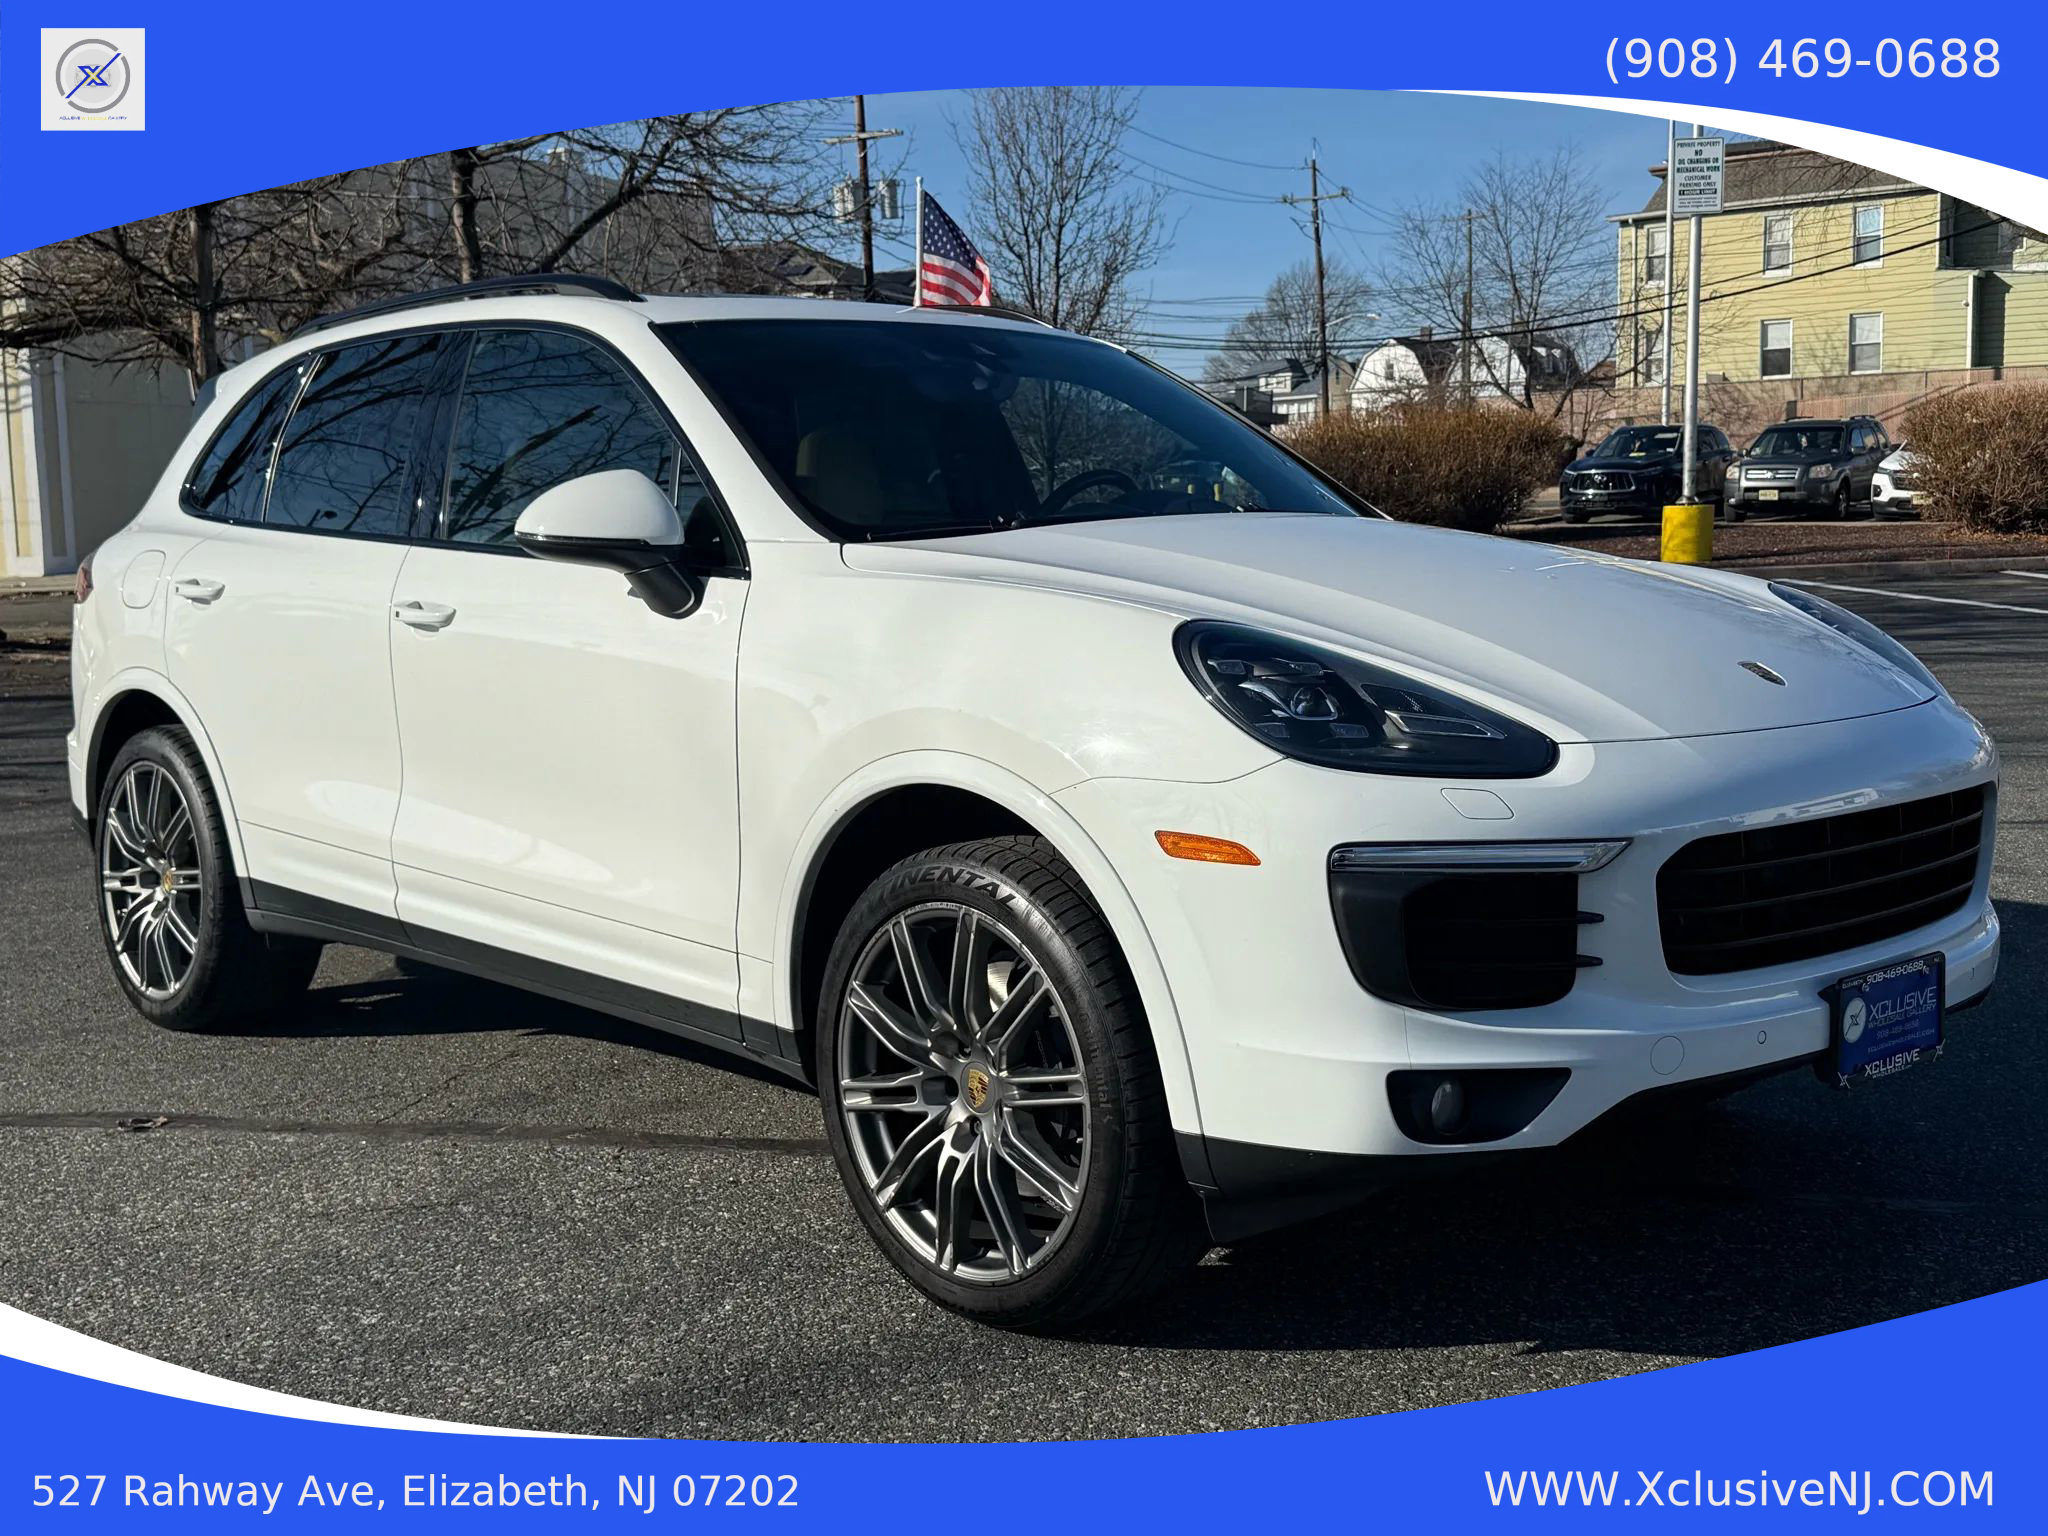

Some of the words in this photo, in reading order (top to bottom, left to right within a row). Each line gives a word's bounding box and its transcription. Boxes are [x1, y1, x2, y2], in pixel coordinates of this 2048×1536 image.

[1687, 157, 1711, 165] CHANGING
[1866, 960, 1924, 984] 908-469-0688
[1867, 1010, 1905, 1028] WHOLESALE
[1906, 1003, 1936, 1017] GALLERY
[1869, 986, 1937, 1021] XCLUSIVE
[1864, 1048, 1920, 1077] XCLUSIVE
